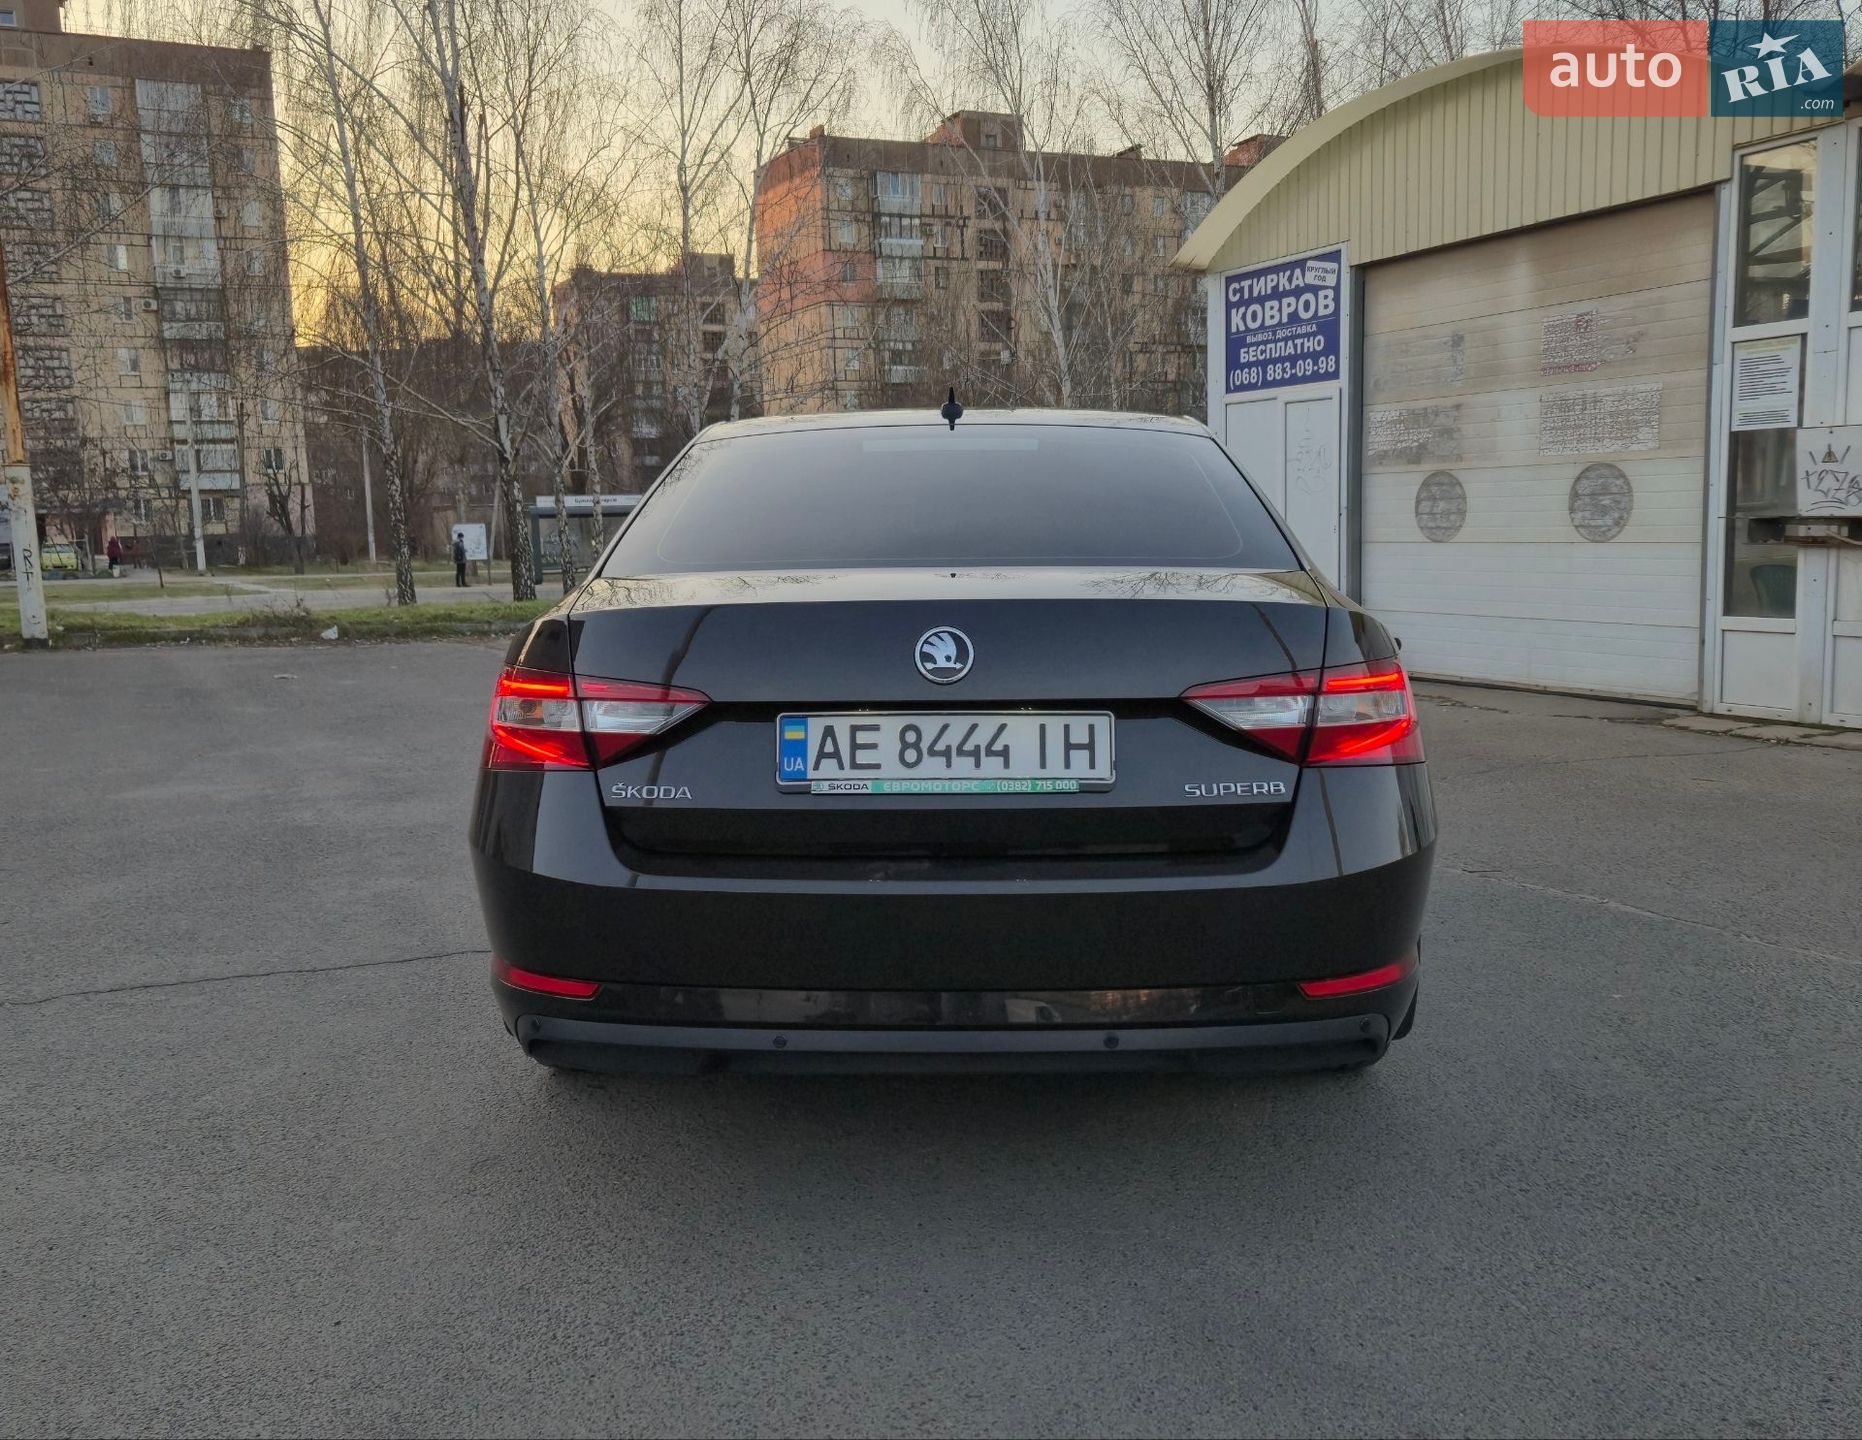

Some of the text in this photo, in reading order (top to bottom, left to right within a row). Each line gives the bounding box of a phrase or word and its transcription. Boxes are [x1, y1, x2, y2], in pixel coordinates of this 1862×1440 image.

[1306, 265, 1336, 276] КРУГЛЫЙ
[1313, 274, 1327, 282] ГОД
[1228, 268, 1305, 302] СТИРКА
[1231, 289, 1335, 333] КОВРОВ
[1246, 323, 1317, 343] ВЫВОЗ, ДОСТАВКА
[1240, 335, 1325, 363] БЕСПЛАТНО
[1230, 355, 1336, 390] (068) 883-09-98
[812, 723, 1096, 771] AE 8444 IH
[784, 757, 805, 771] UA
[611, 782, 693, 800] ŠKODA
[996, 780, 1031, 792] (0382)
[1036, 781, 1053, 791] 715
[1055, 780, 1077, 791] 000
[1184, 781, 1286, 797] SUPERB
